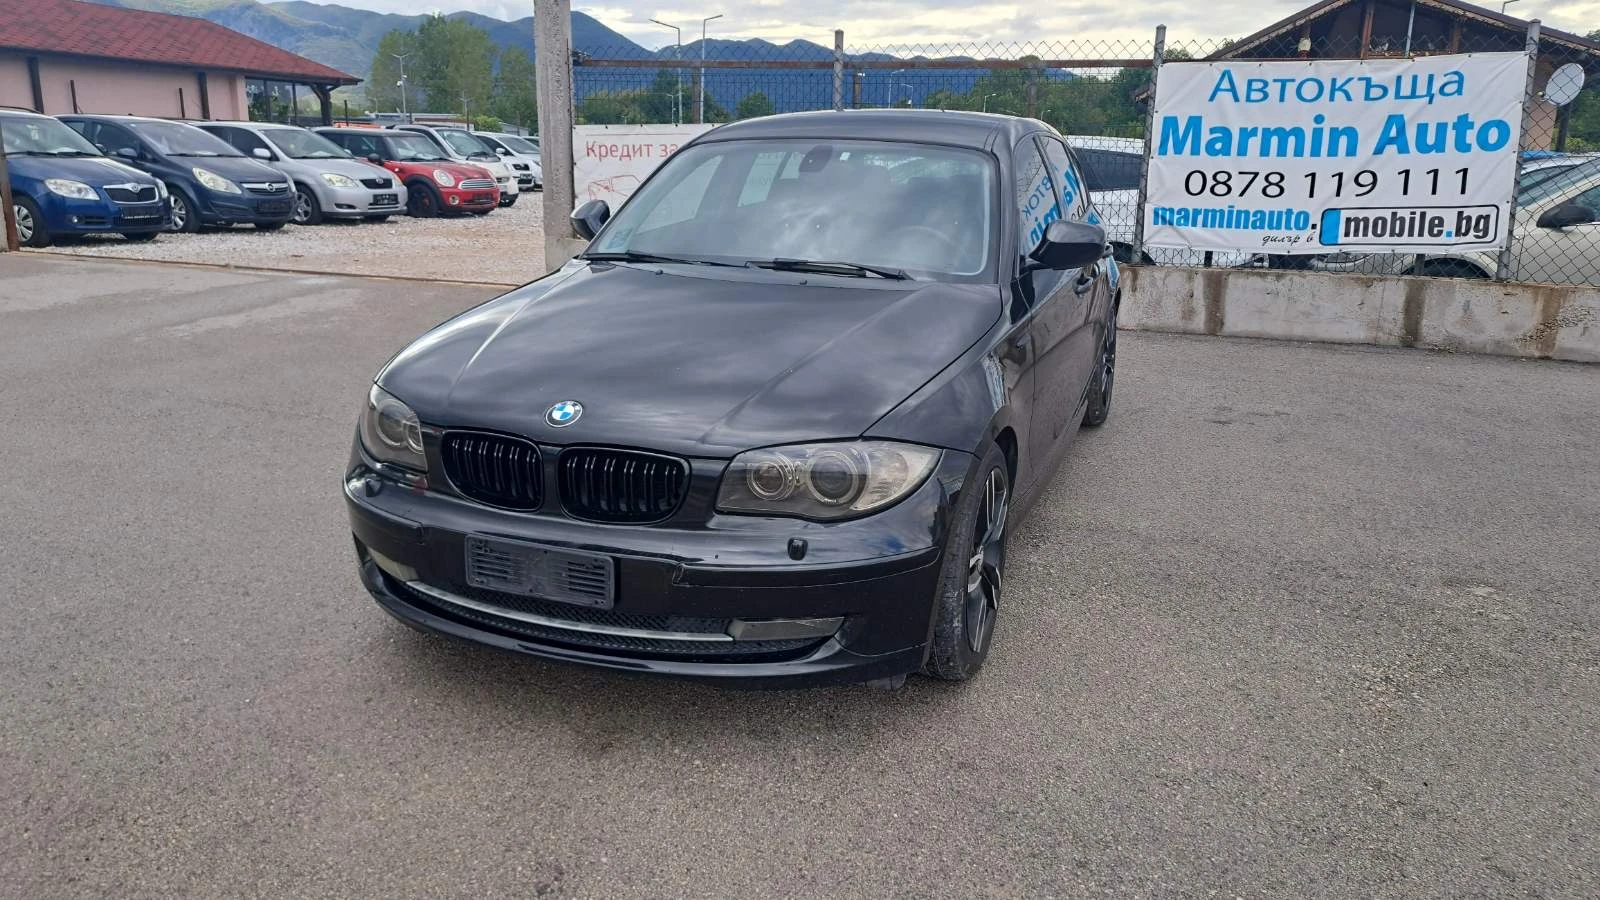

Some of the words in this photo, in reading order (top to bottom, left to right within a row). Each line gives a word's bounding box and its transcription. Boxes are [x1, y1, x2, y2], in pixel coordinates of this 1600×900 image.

[1207, 68, 1465, 105] Автокъща
[1157, 113, 1359, 158] Marmin
[1373, 112, 1512, 156] Auto
[586, 141, 653, 161] Кредит
[1184, 169, 1285, 198] 0878
[1304, 169, 1378, 198] 119
[1397, 167, 1469, 196] 111
[1343, 210, 1491, 240] mobile.bg
